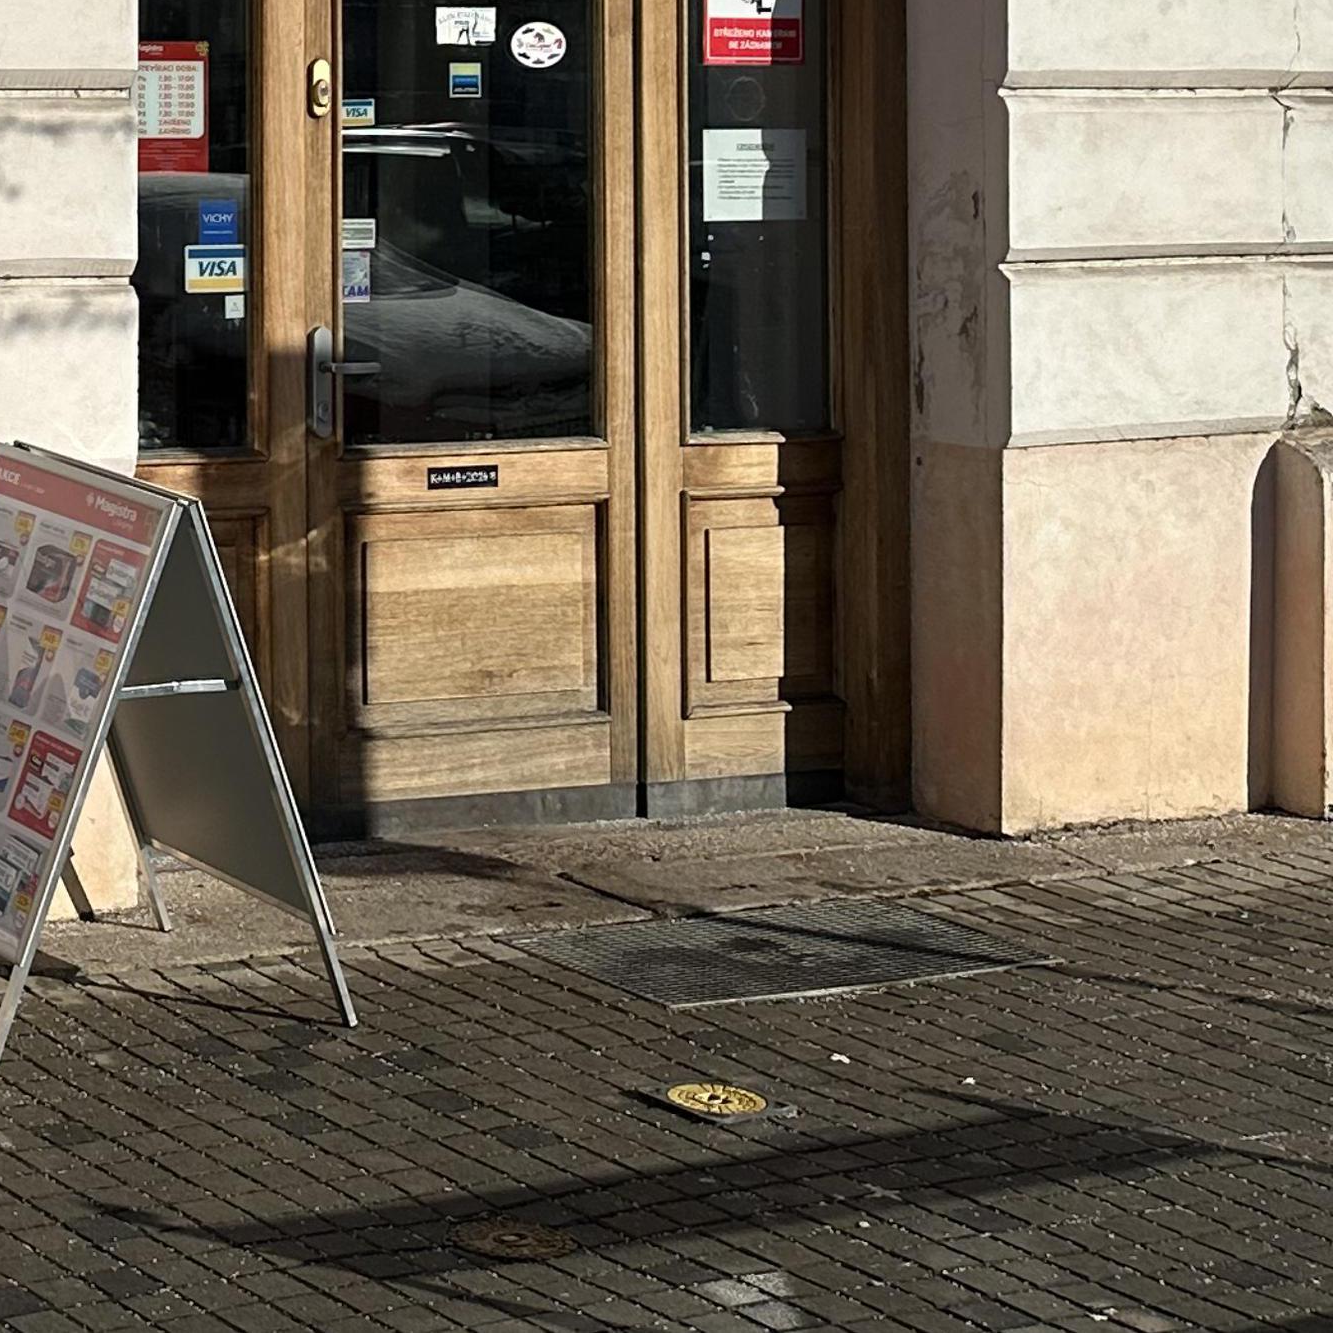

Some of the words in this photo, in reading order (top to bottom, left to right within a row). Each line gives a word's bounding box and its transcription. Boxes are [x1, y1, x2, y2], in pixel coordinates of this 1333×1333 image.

[345, 108, 368, 117] VISA
[202, 214, 233, 223] VICHY
[198, 260, 237, 277] VISA
[94, 495, 137, 521] Magistra
